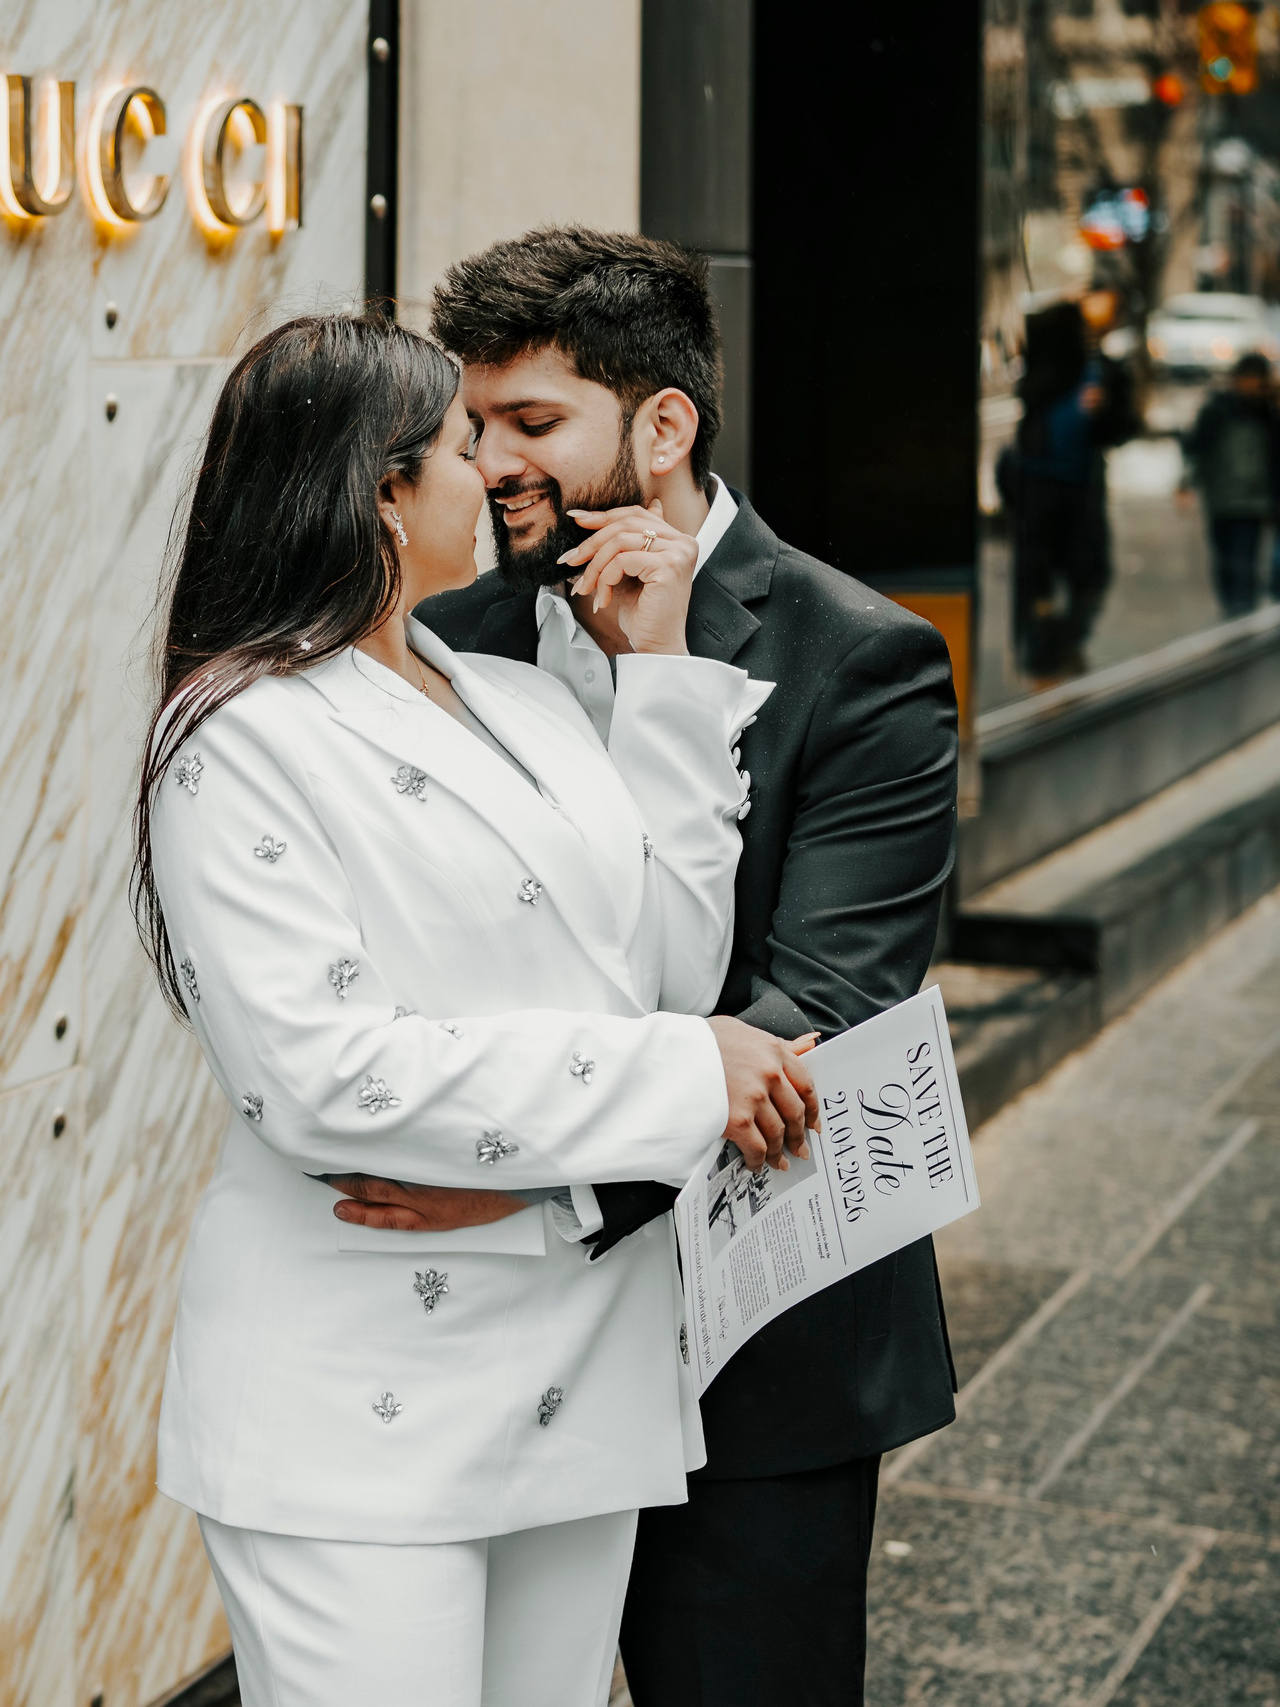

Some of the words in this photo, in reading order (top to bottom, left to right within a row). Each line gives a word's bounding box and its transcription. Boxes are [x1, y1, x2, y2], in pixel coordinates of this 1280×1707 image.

[907, 1042, 942, 1126] SAVE
[823, 1091, 868, 1222] 21.04.2026
[857, 1084, 914, 1195] Date
[923, 1126, 953, 1188] THE
[695, 1242, 703, 1273] excited
[697, 1273, 702, 1284] to
[698, 1285, 706, 1324] celebrate
[702, 1346, 714, 1369] you!
